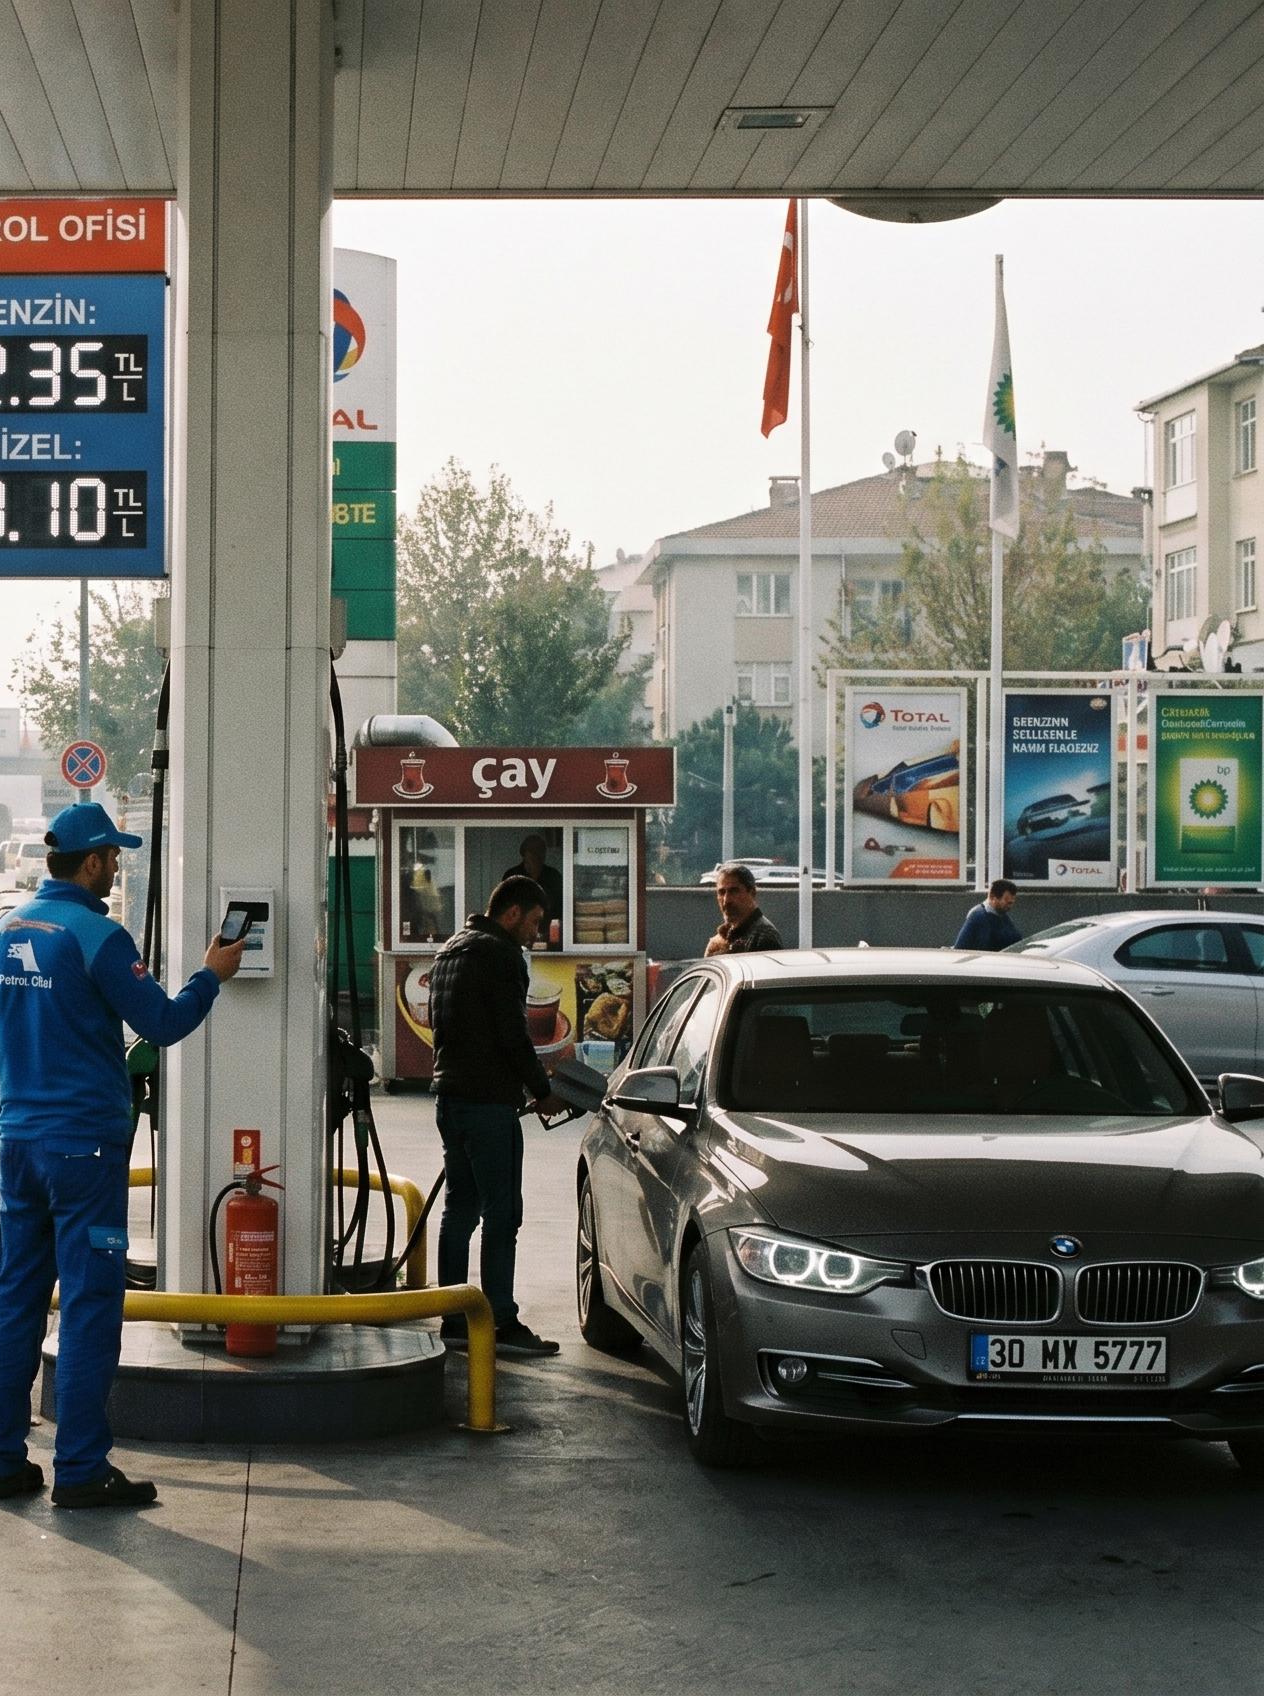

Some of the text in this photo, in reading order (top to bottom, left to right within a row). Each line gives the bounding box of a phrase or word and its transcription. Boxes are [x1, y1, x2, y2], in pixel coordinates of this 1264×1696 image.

[59, 207, 146, 242] OFİSİ
[114, 353, 143, 372] TL
[122, 382, 136, 401] L
[333, 408, 378, 431] AL
[113, 488, 142, 507] TL
[122, 518, 135, 537] L
[890, 709, 950, 723] TOTAL
[472, 757, 557, 799] çay
[989, 1338, 1163, 1371] 30 MX 5777
